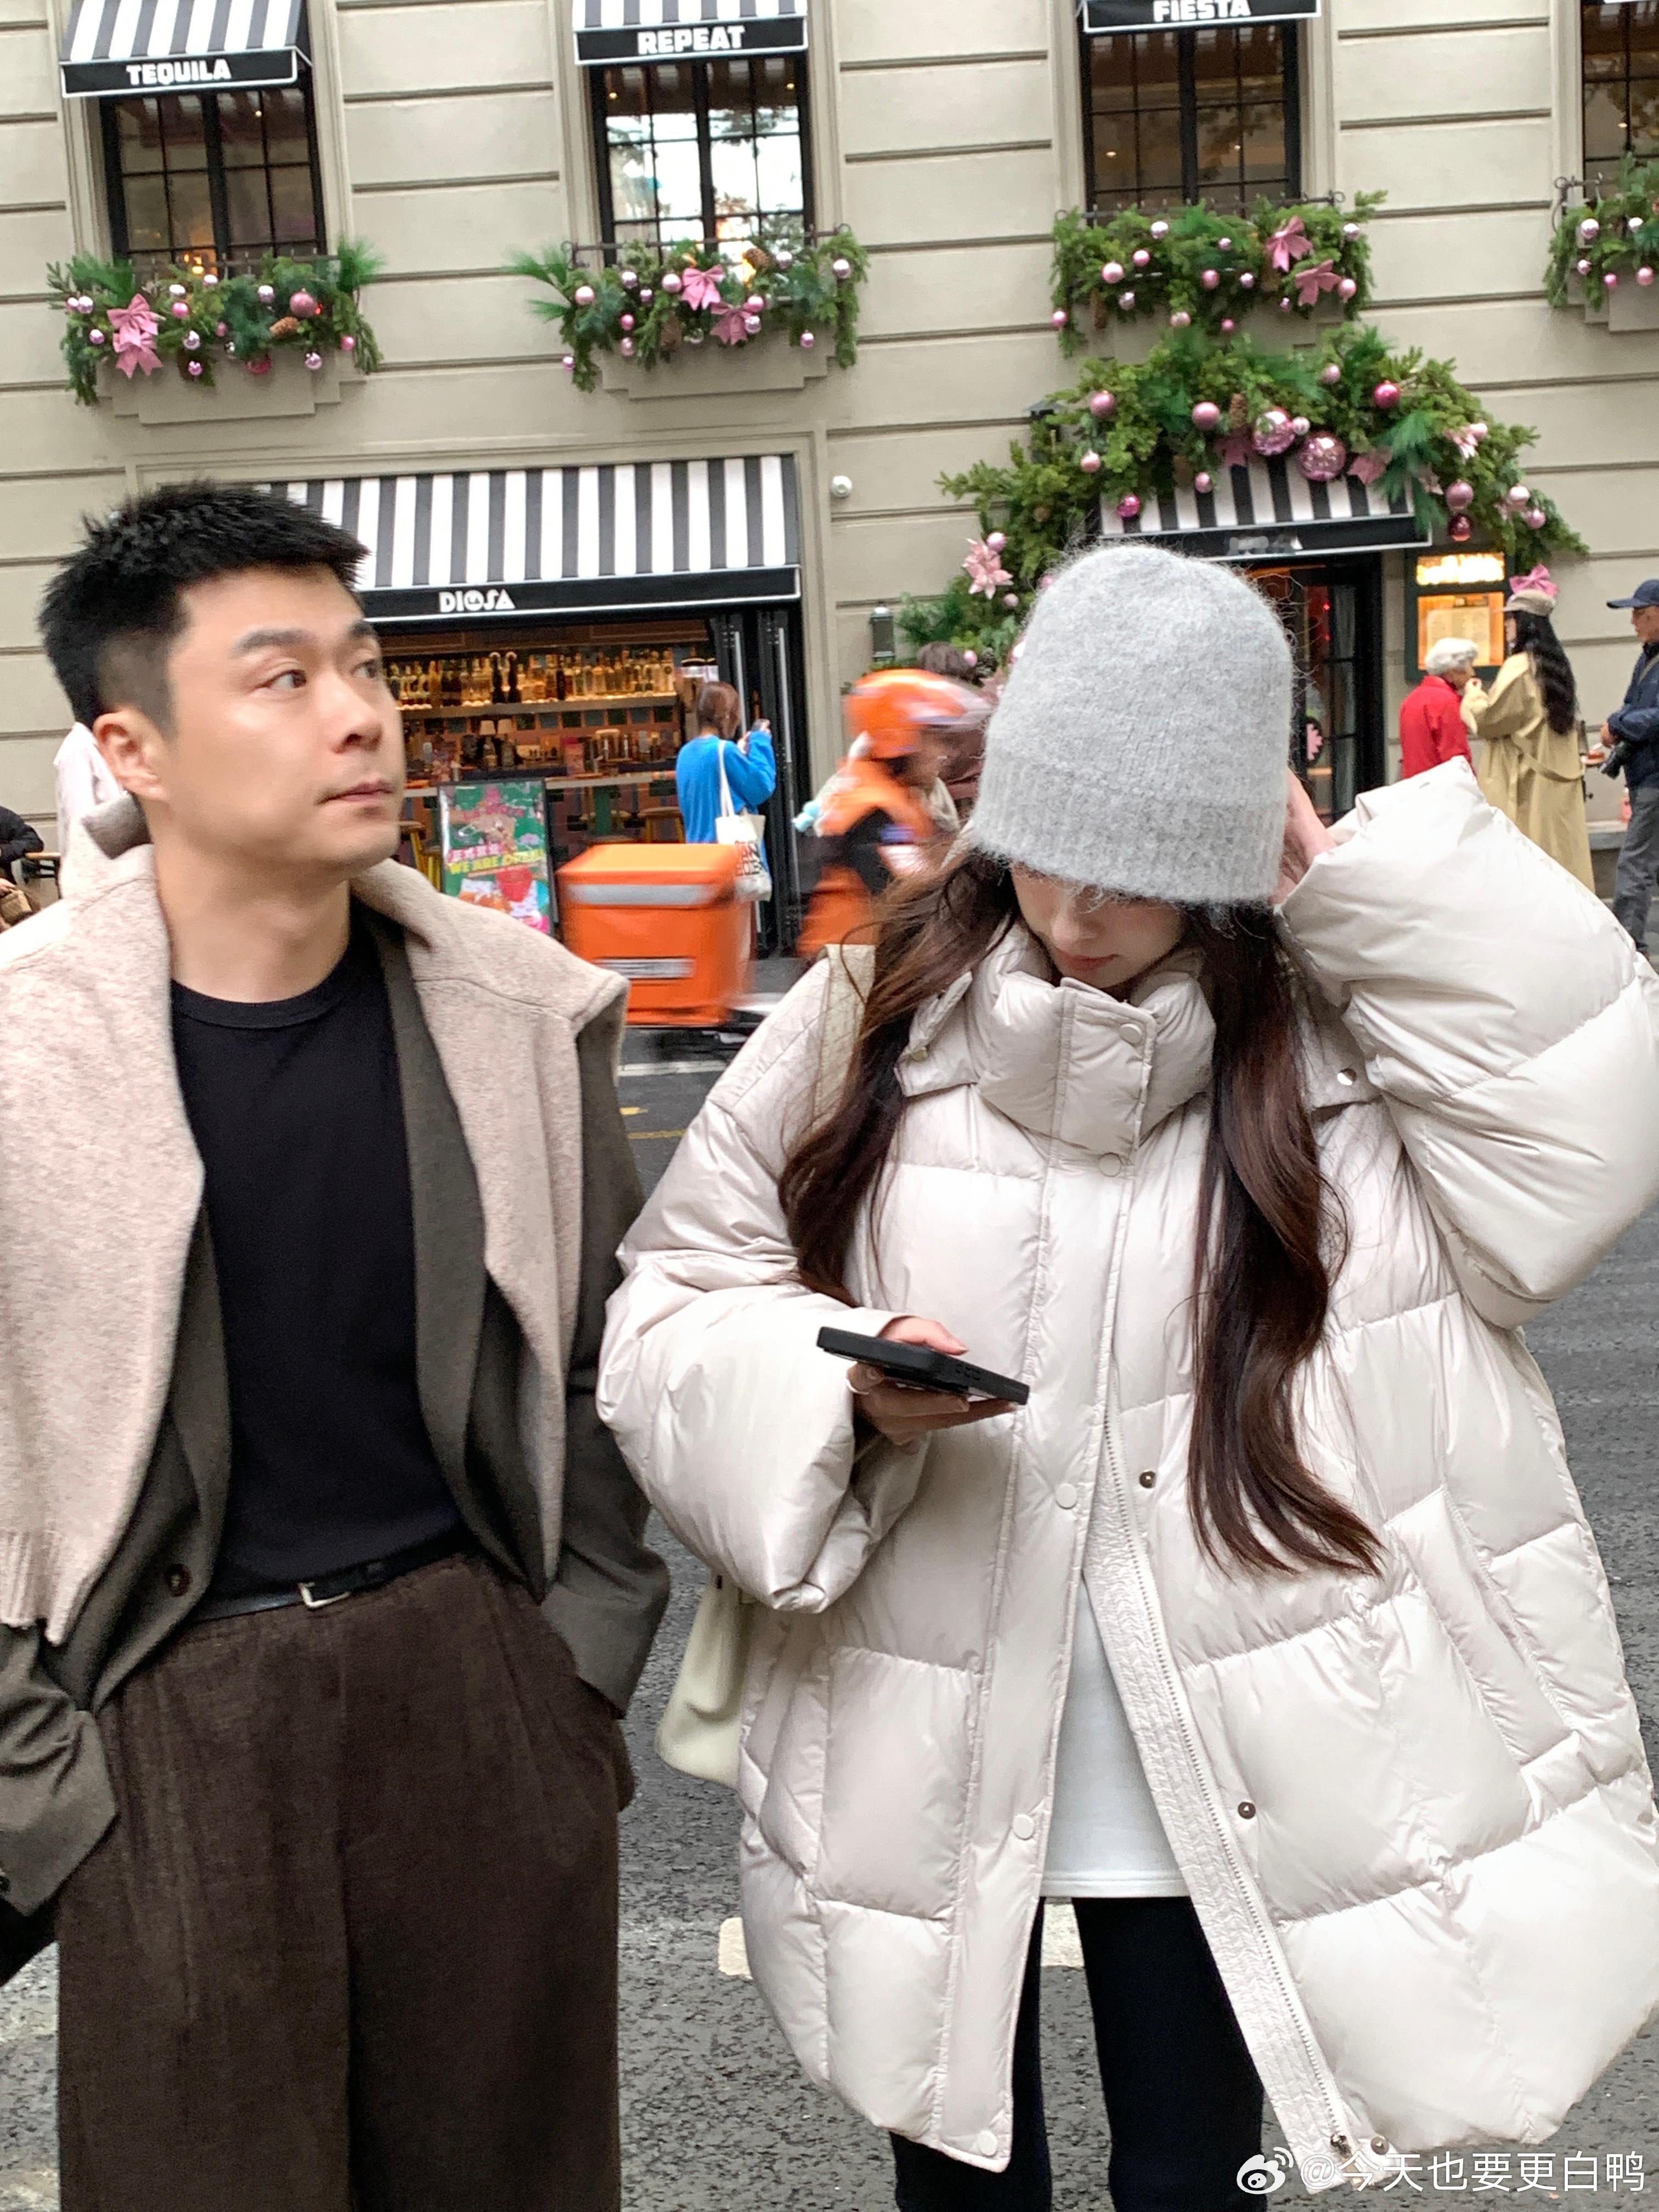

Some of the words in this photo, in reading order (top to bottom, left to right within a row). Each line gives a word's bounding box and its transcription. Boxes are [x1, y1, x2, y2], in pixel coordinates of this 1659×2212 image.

[1153, 0, 1251, 22] FIESTA
[637, 25, 746, 54] REPEAT
[126, 59, 232, 86] TEQUILA
[439, 589, 516, 612] DIOSA
